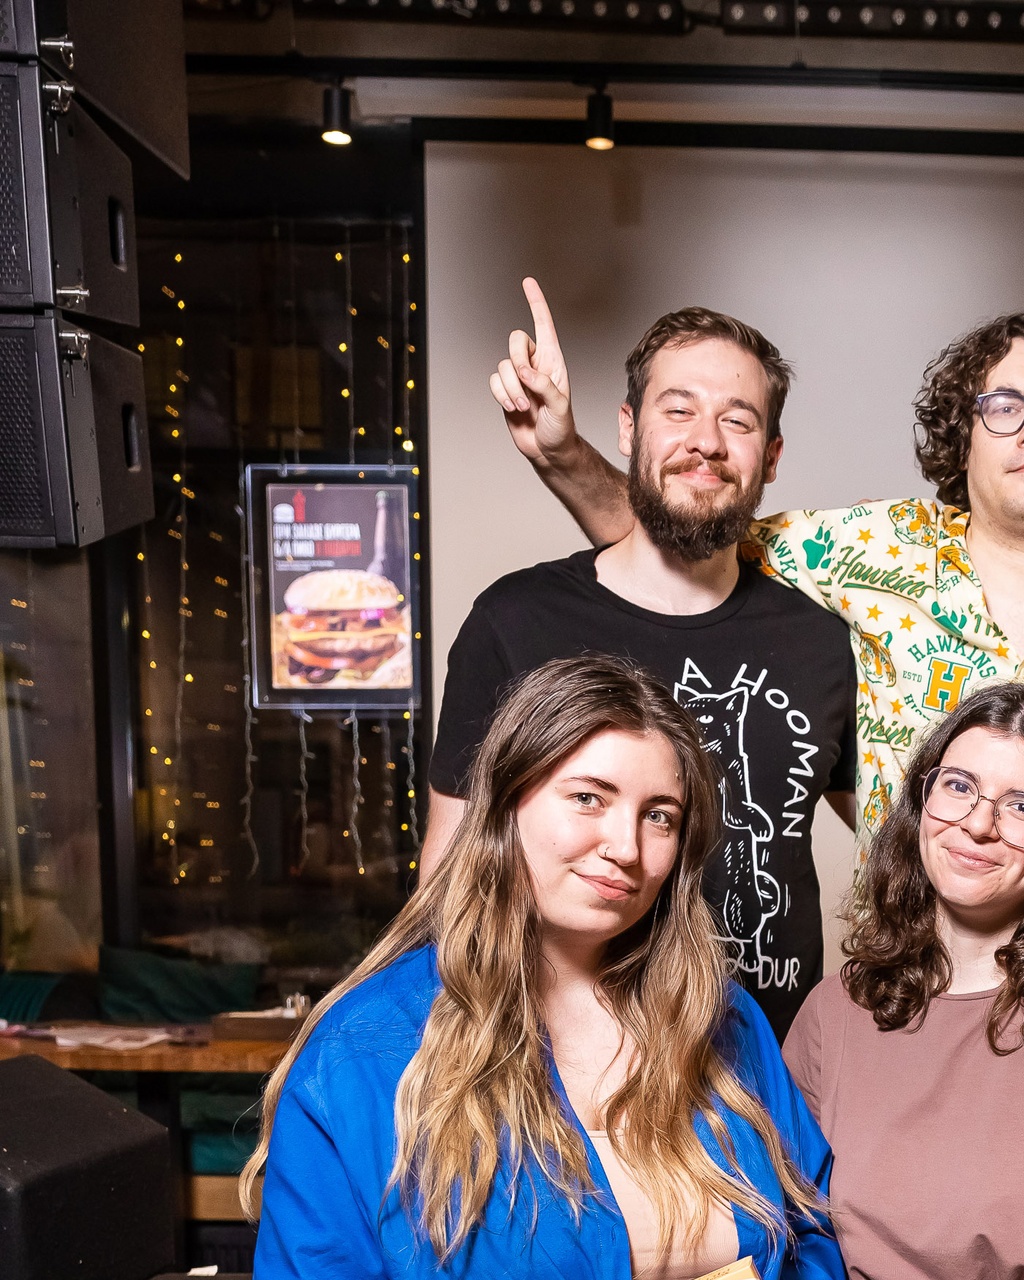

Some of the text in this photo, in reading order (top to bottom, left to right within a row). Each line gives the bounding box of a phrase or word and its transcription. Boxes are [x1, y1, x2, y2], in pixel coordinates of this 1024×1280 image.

[831, 545, 934, 599] Hawkins
[902, 670, 923, 683] ESTD
[907, 634, 998, 679] HAWKINS
[682, 657, 819, 838] A HOOMAN
